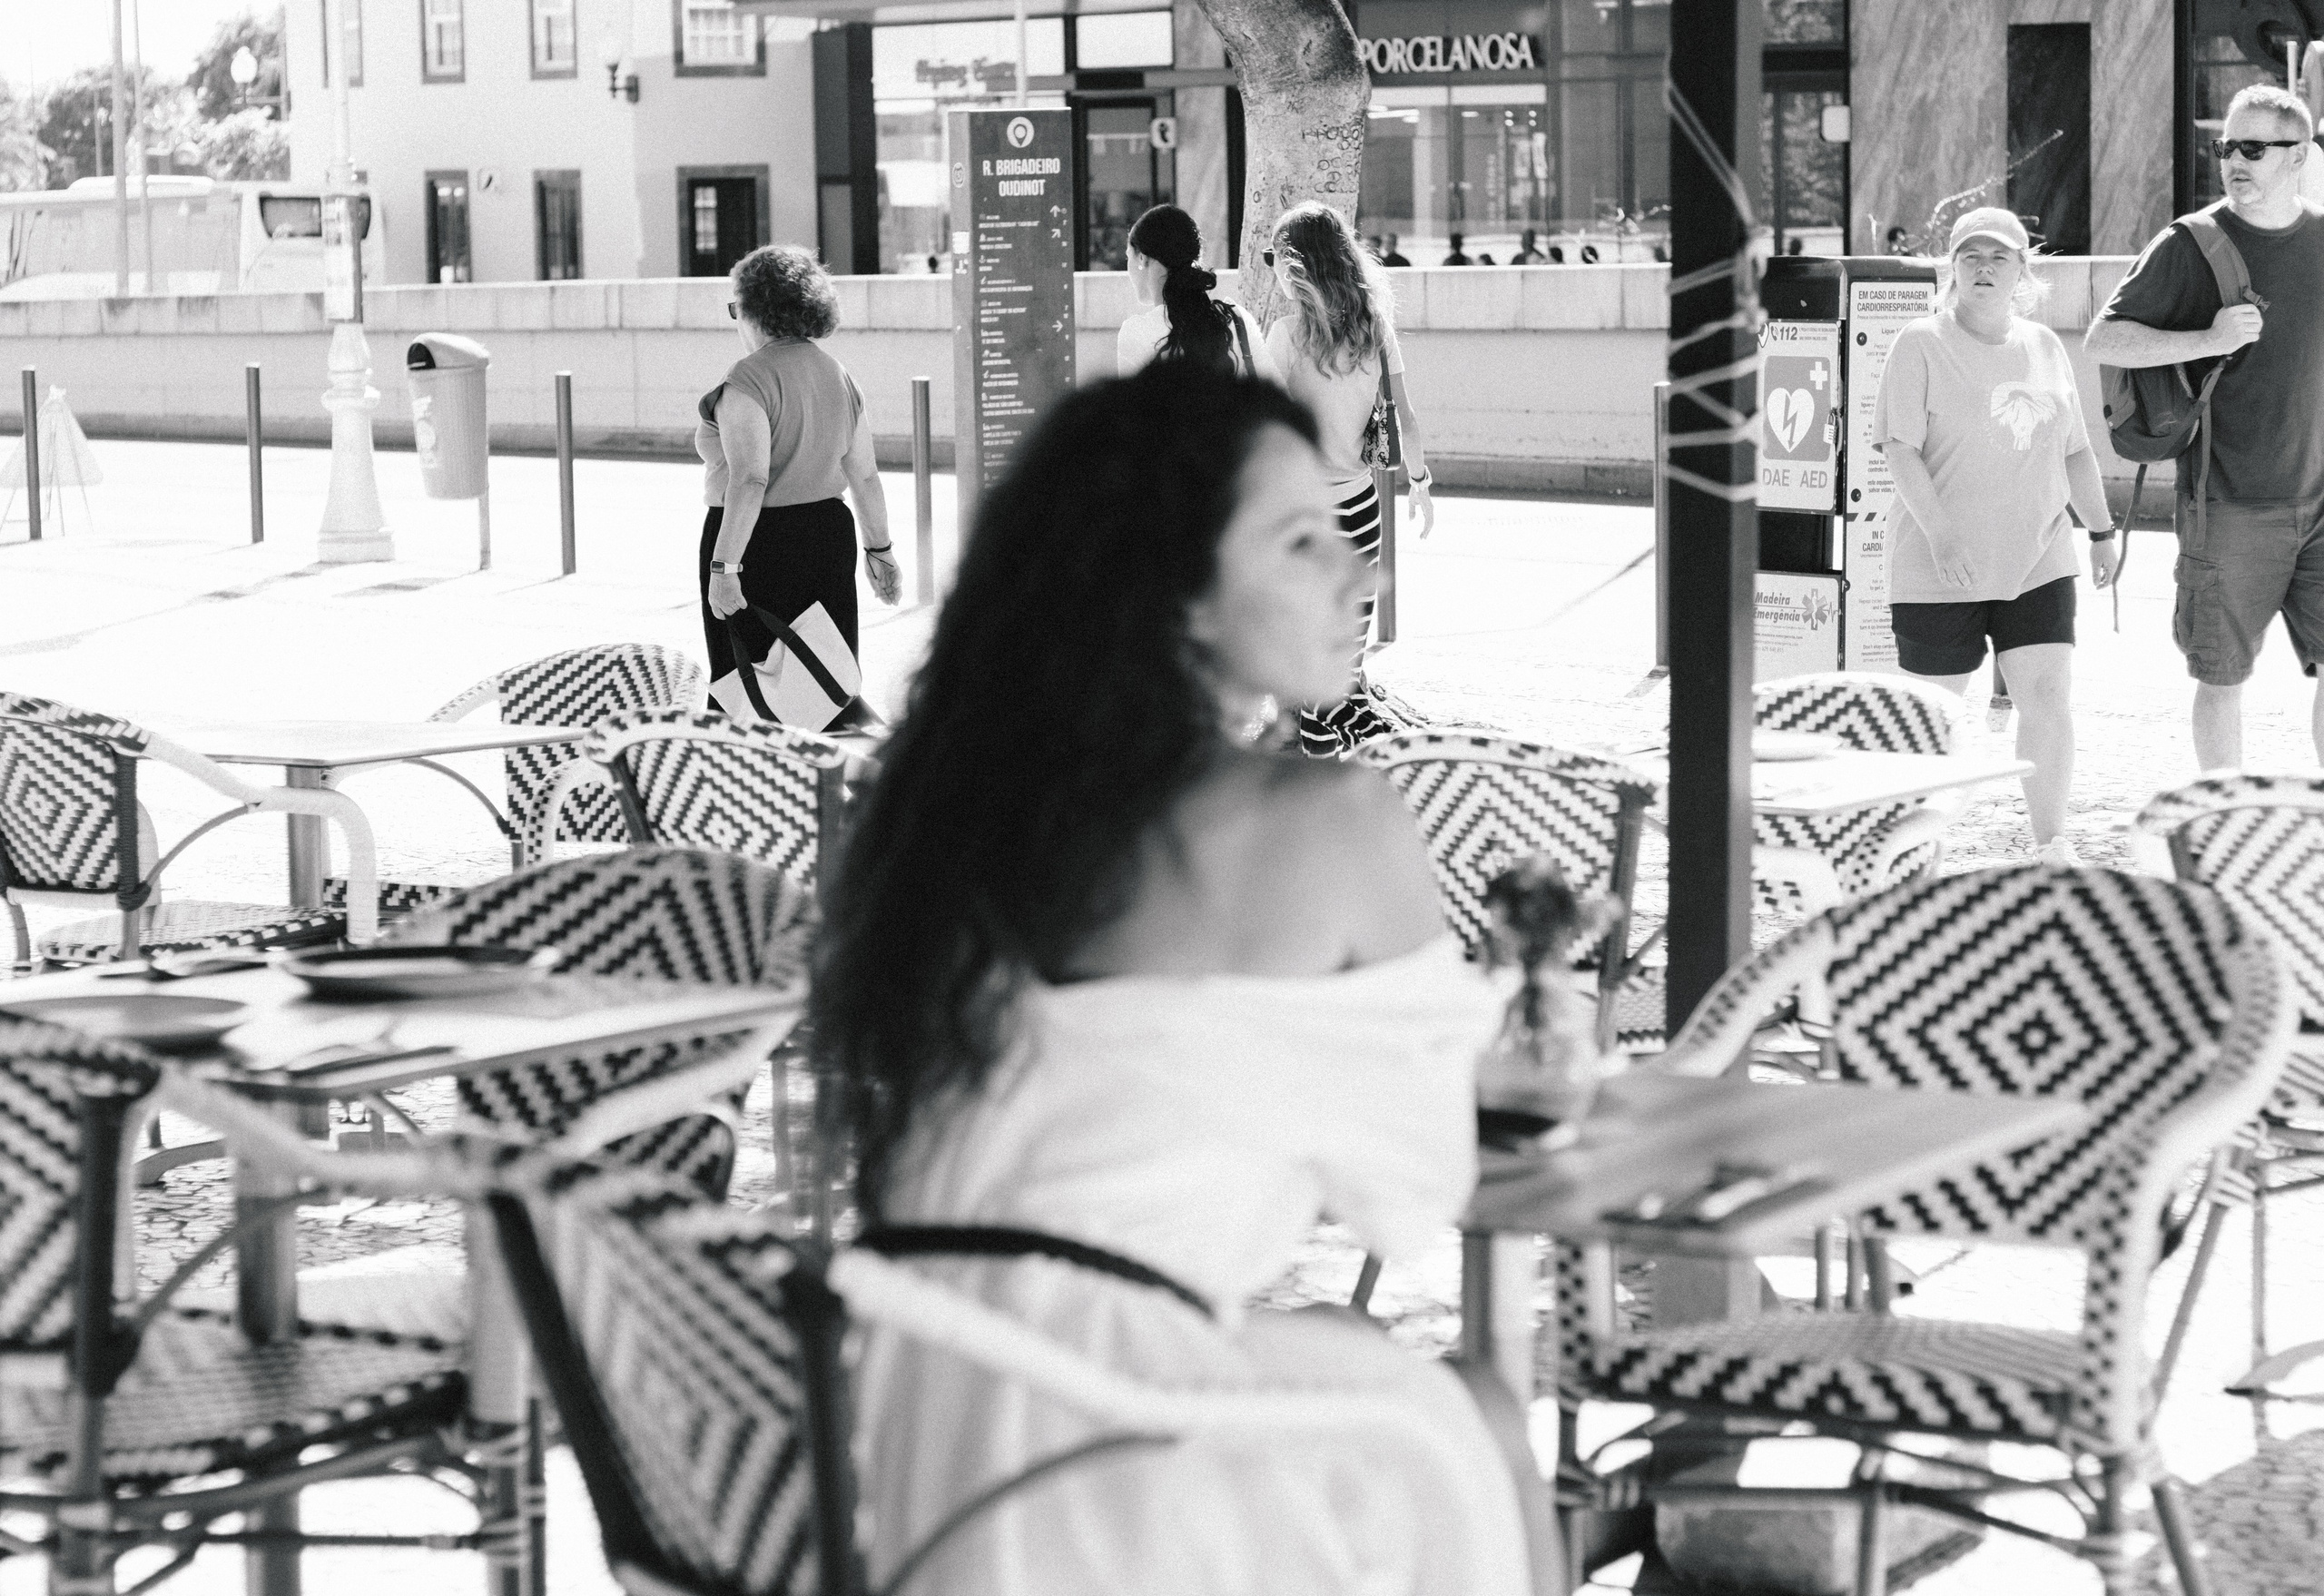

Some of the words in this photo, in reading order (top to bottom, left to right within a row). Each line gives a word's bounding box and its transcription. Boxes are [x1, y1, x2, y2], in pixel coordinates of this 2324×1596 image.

[1359, 32, 1534, 74] PORCELANOSA
[982, 160, 994, 176] R.
[996, 158, 1061, 175] BRIGADEIRO
[999, 180, 1046, 197] OUDINOT
[1858, 291, 1868, 300] EM
[1869, 291, 1887, 300] CASO
[1888, 291, 1896, 300] DE
[1897, 291, 1928, 300] PARAGEM
[1856, 301, 1929, 312] CARDIORRESPIRATÓRIA
[1779, 326, 1798, 340] 112
[1762, 468, 1791, 487] DAE
[1800, 469, 1827, 489] AED
[1872, 530, 1879, 539] IN
[1754, 592, 1791, 606] Madeira
